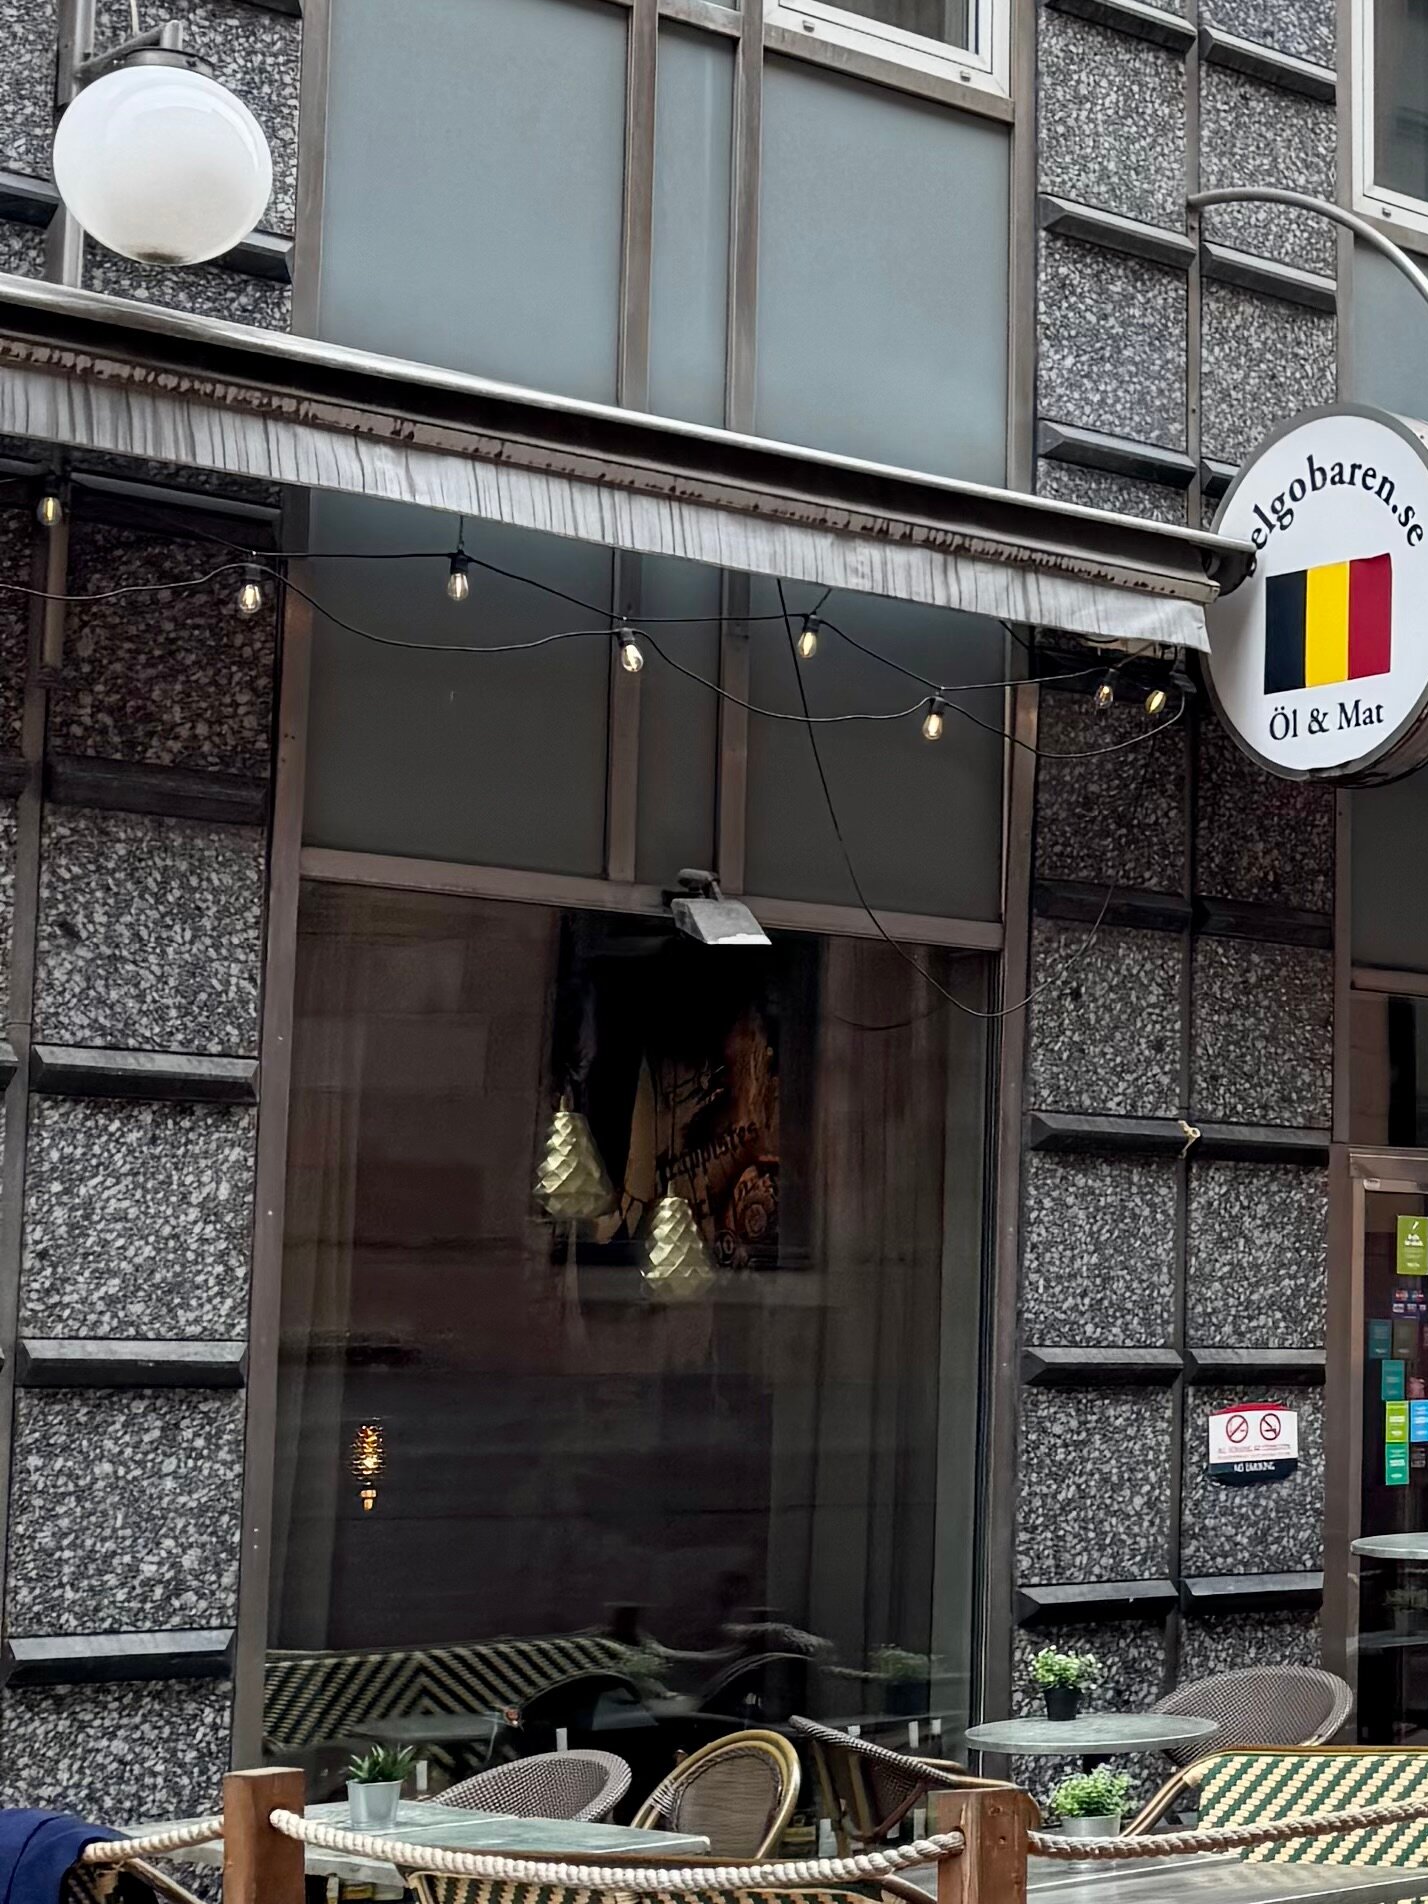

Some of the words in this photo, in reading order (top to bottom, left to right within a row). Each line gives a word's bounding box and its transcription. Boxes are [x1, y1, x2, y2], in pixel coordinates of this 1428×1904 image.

[1268, 706, 1299, 741] Öl
[1307, 707, 1330, 734] &
[1337, 699, 1385, 731] Mat
